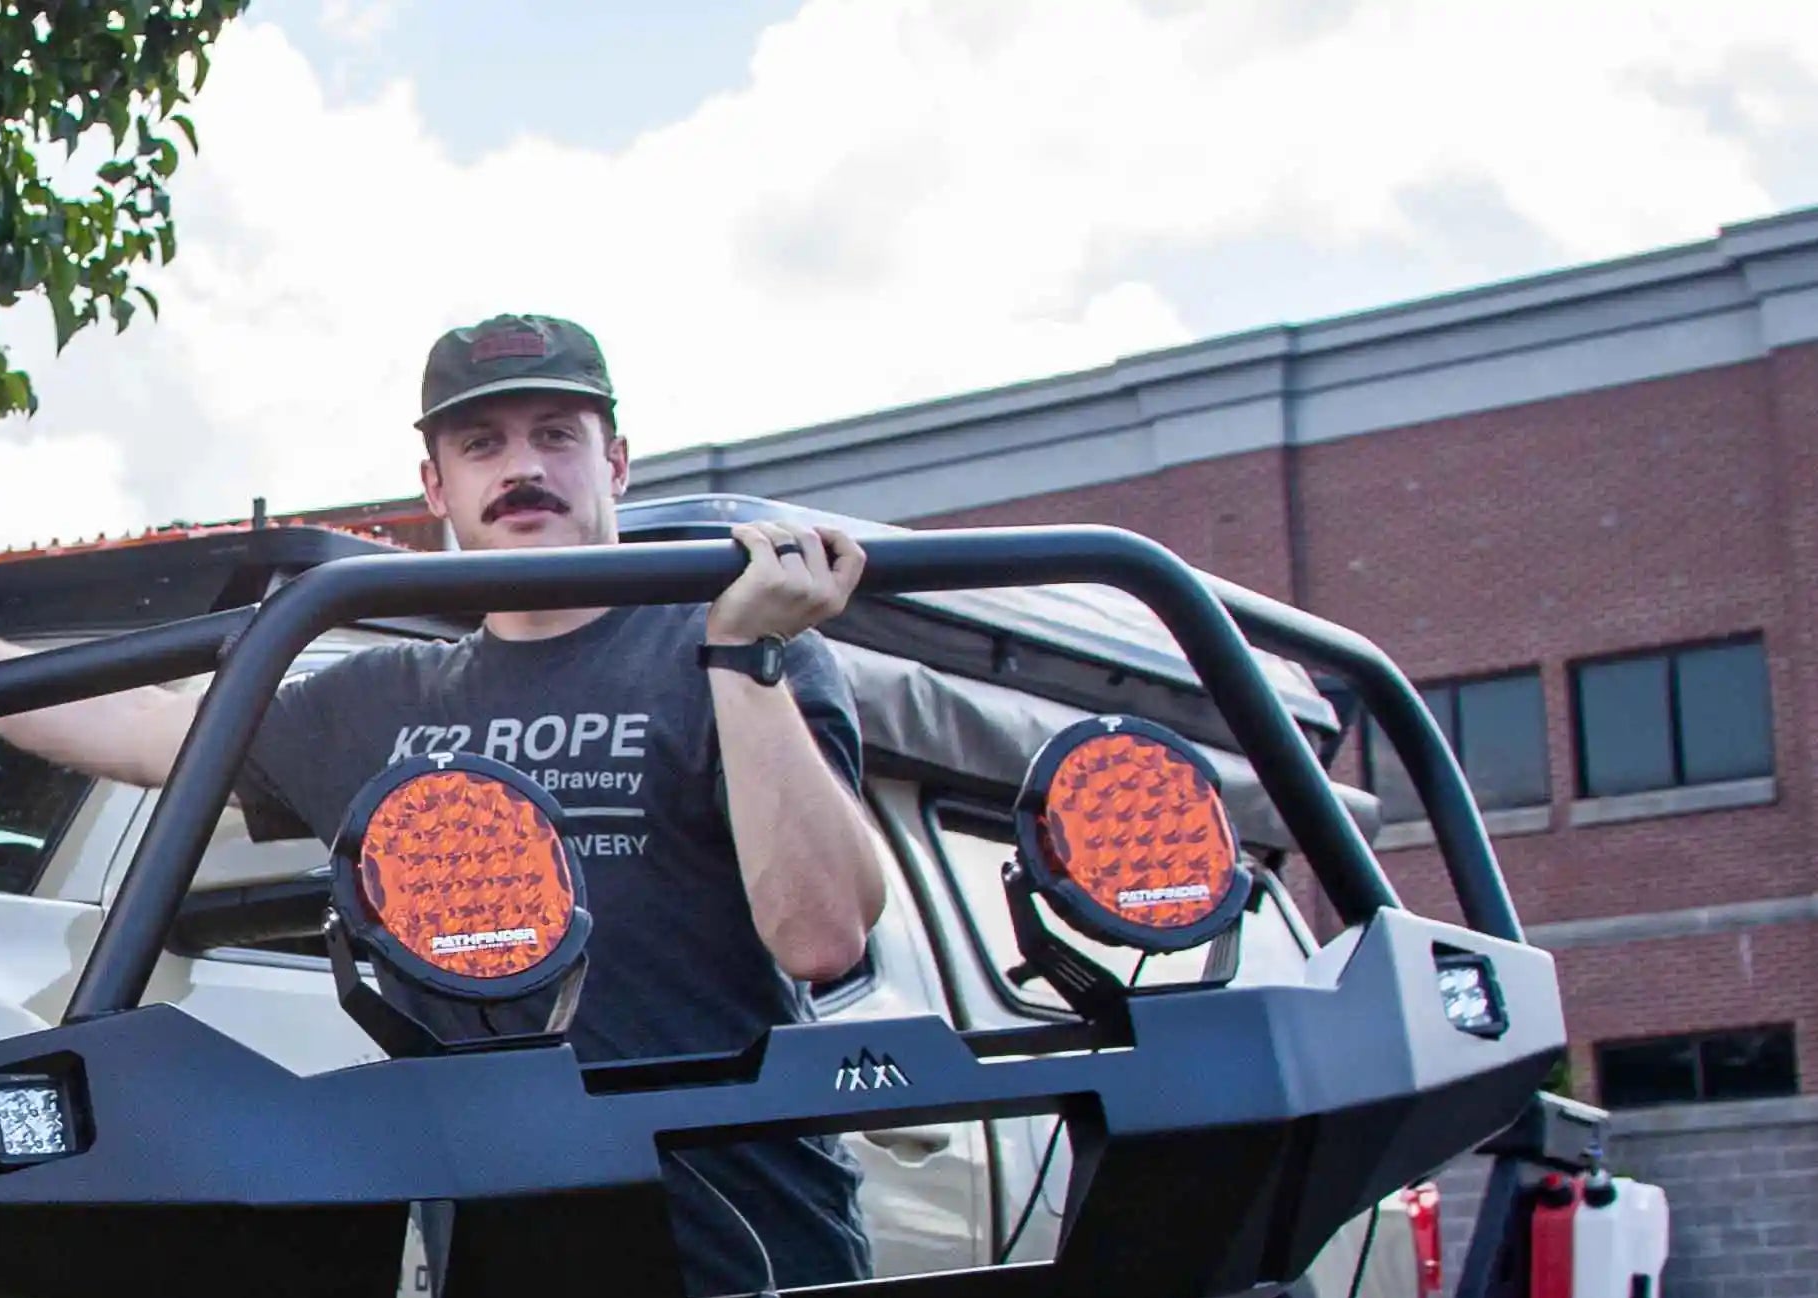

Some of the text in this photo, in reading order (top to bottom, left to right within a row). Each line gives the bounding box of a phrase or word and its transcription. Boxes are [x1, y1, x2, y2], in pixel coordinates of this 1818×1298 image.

[387, 713, 650, 765] K72 ROPE
[544, 768, 643, 795] Bravery
